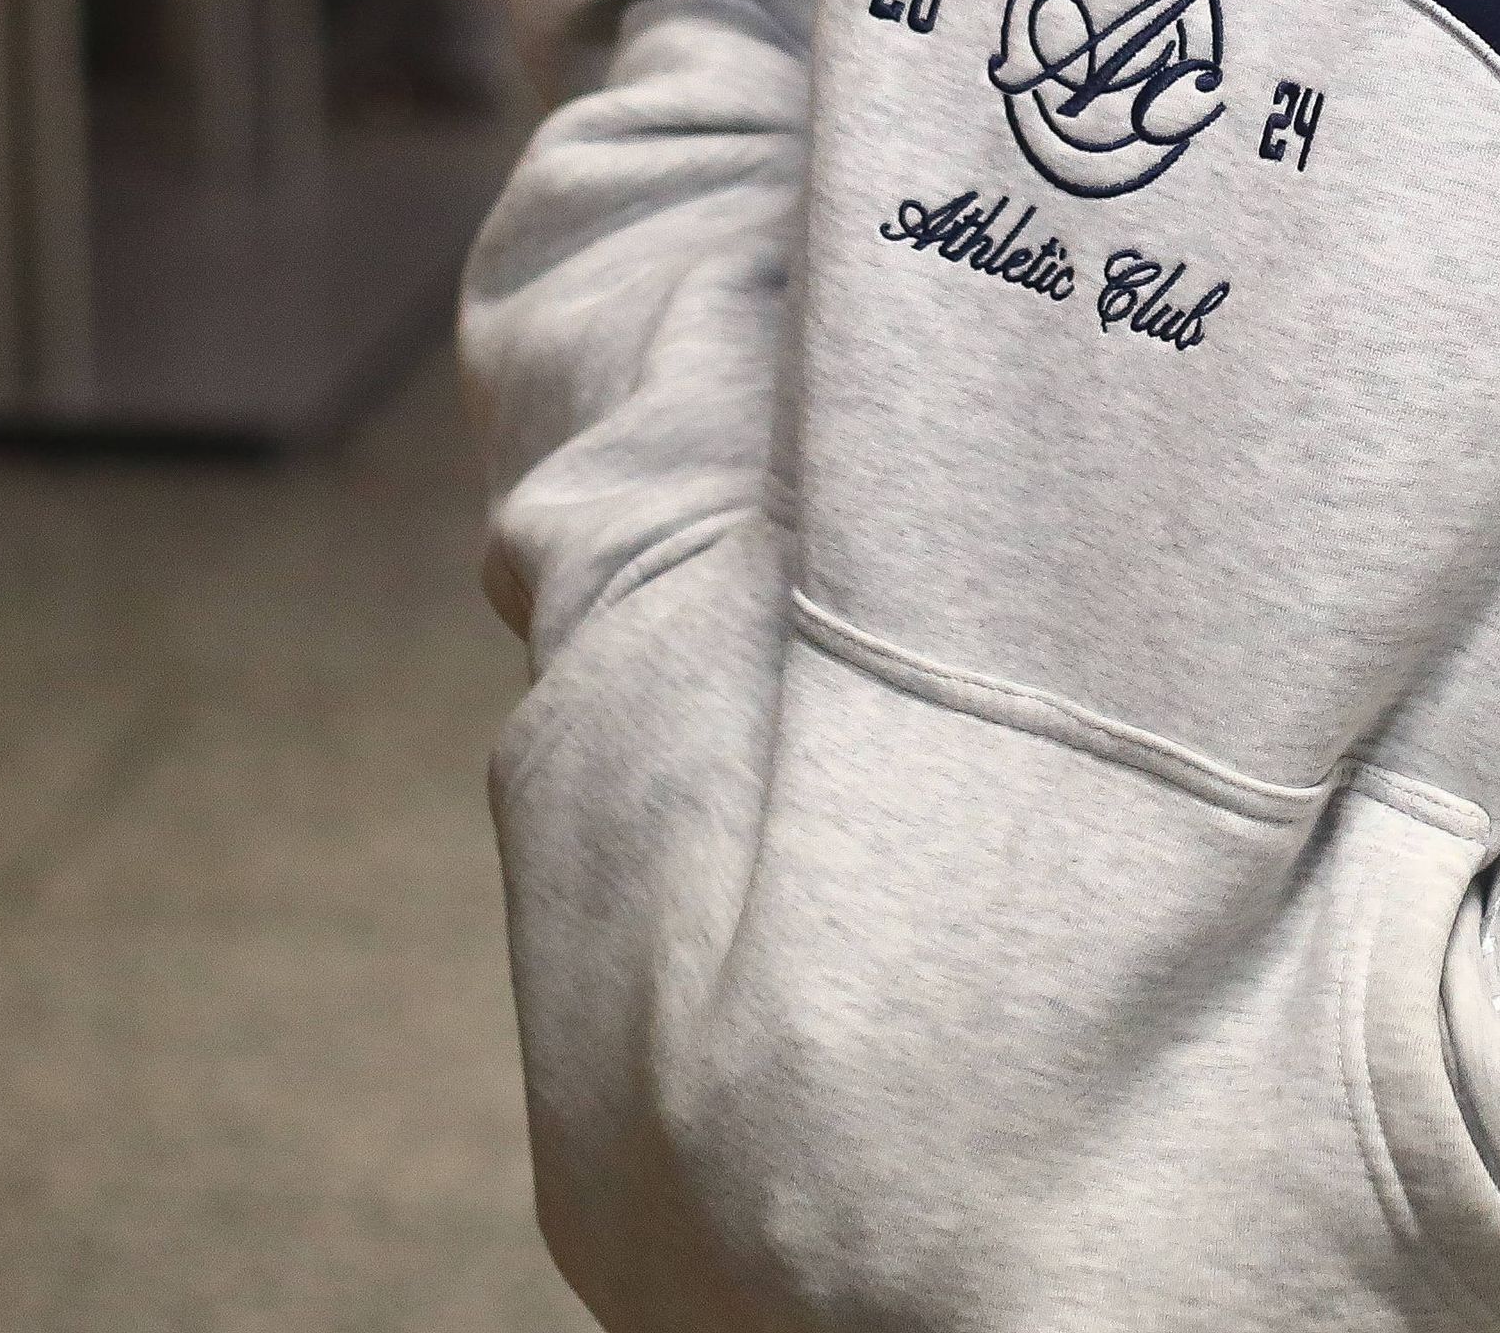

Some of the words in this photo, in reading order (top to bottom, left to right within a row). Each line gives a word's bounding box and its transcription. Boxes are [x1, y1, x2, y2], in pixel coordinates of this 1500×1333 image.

[1258, 79, 1325, 173] 24
[879, 189, 1076, 302] Athletic
[1097, 247, 1231, 351] Club
